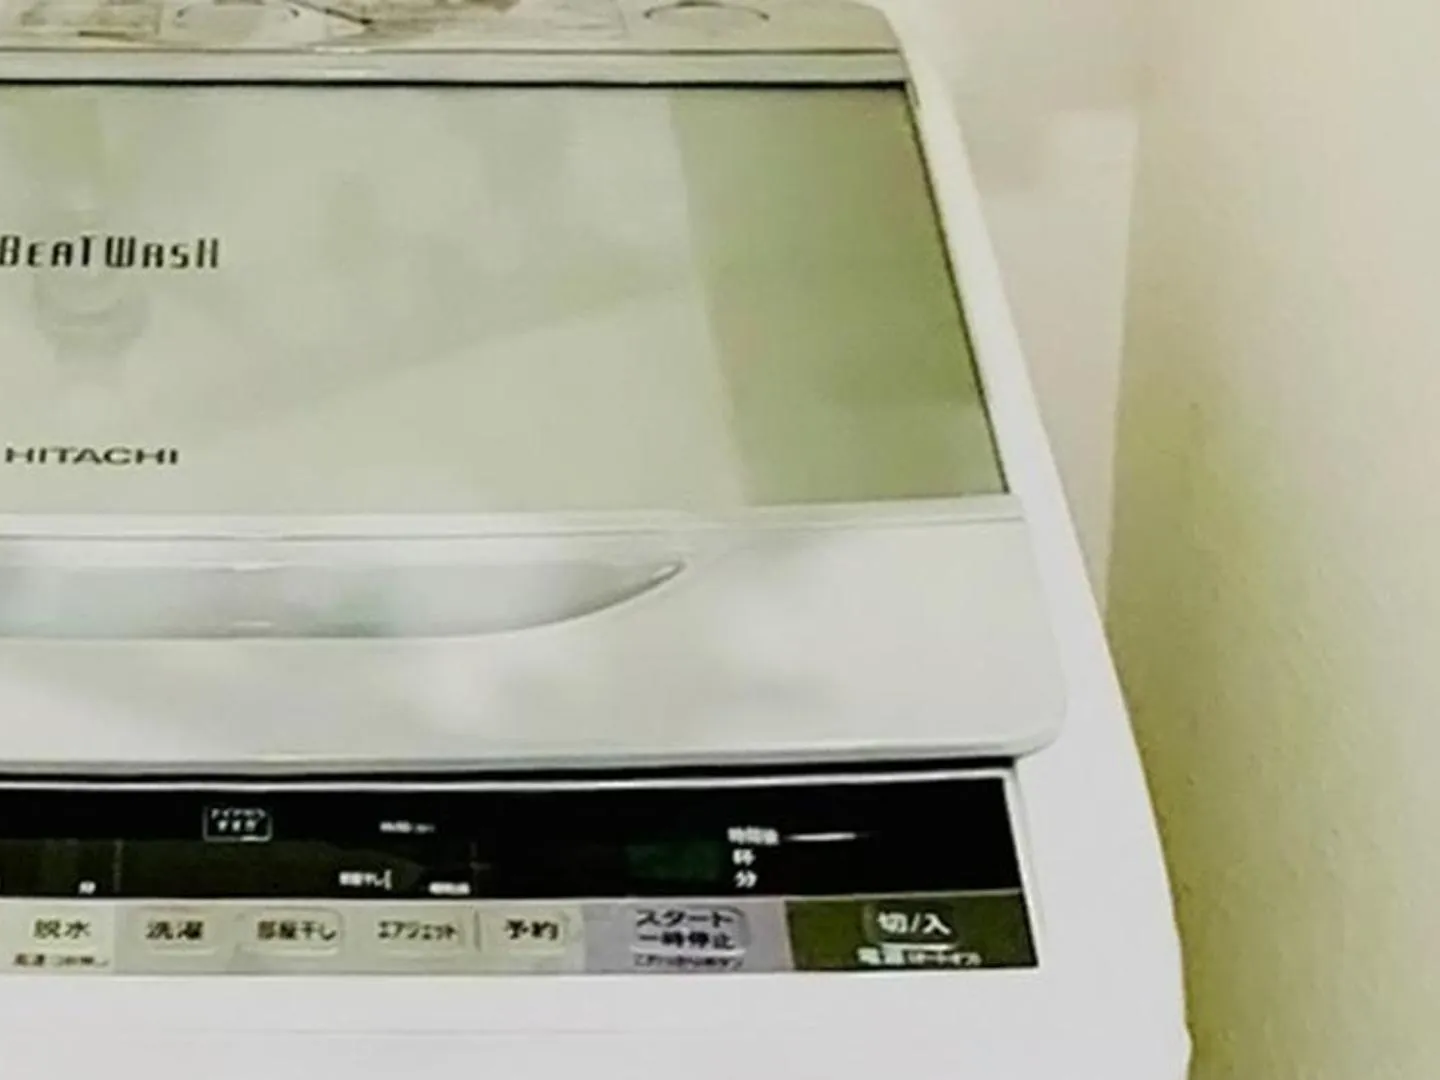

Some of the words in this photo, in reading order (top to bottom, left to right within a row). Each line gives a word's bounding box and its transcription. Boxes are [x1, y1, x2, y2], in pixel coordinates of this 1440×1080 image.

[5, 447, 179, 465] HITACHI
[636, 909, 734, 928] スタート
[877, 912, 951, 935] 切/入
[34, 919, 92, 939] 脱水
[146, 920, 204, 940] 洗濯
[258, 920, 337, 941] 部屋干し
[505, 919, 559, 941] 予約
[638, 931, 736, 949] 一時停止
